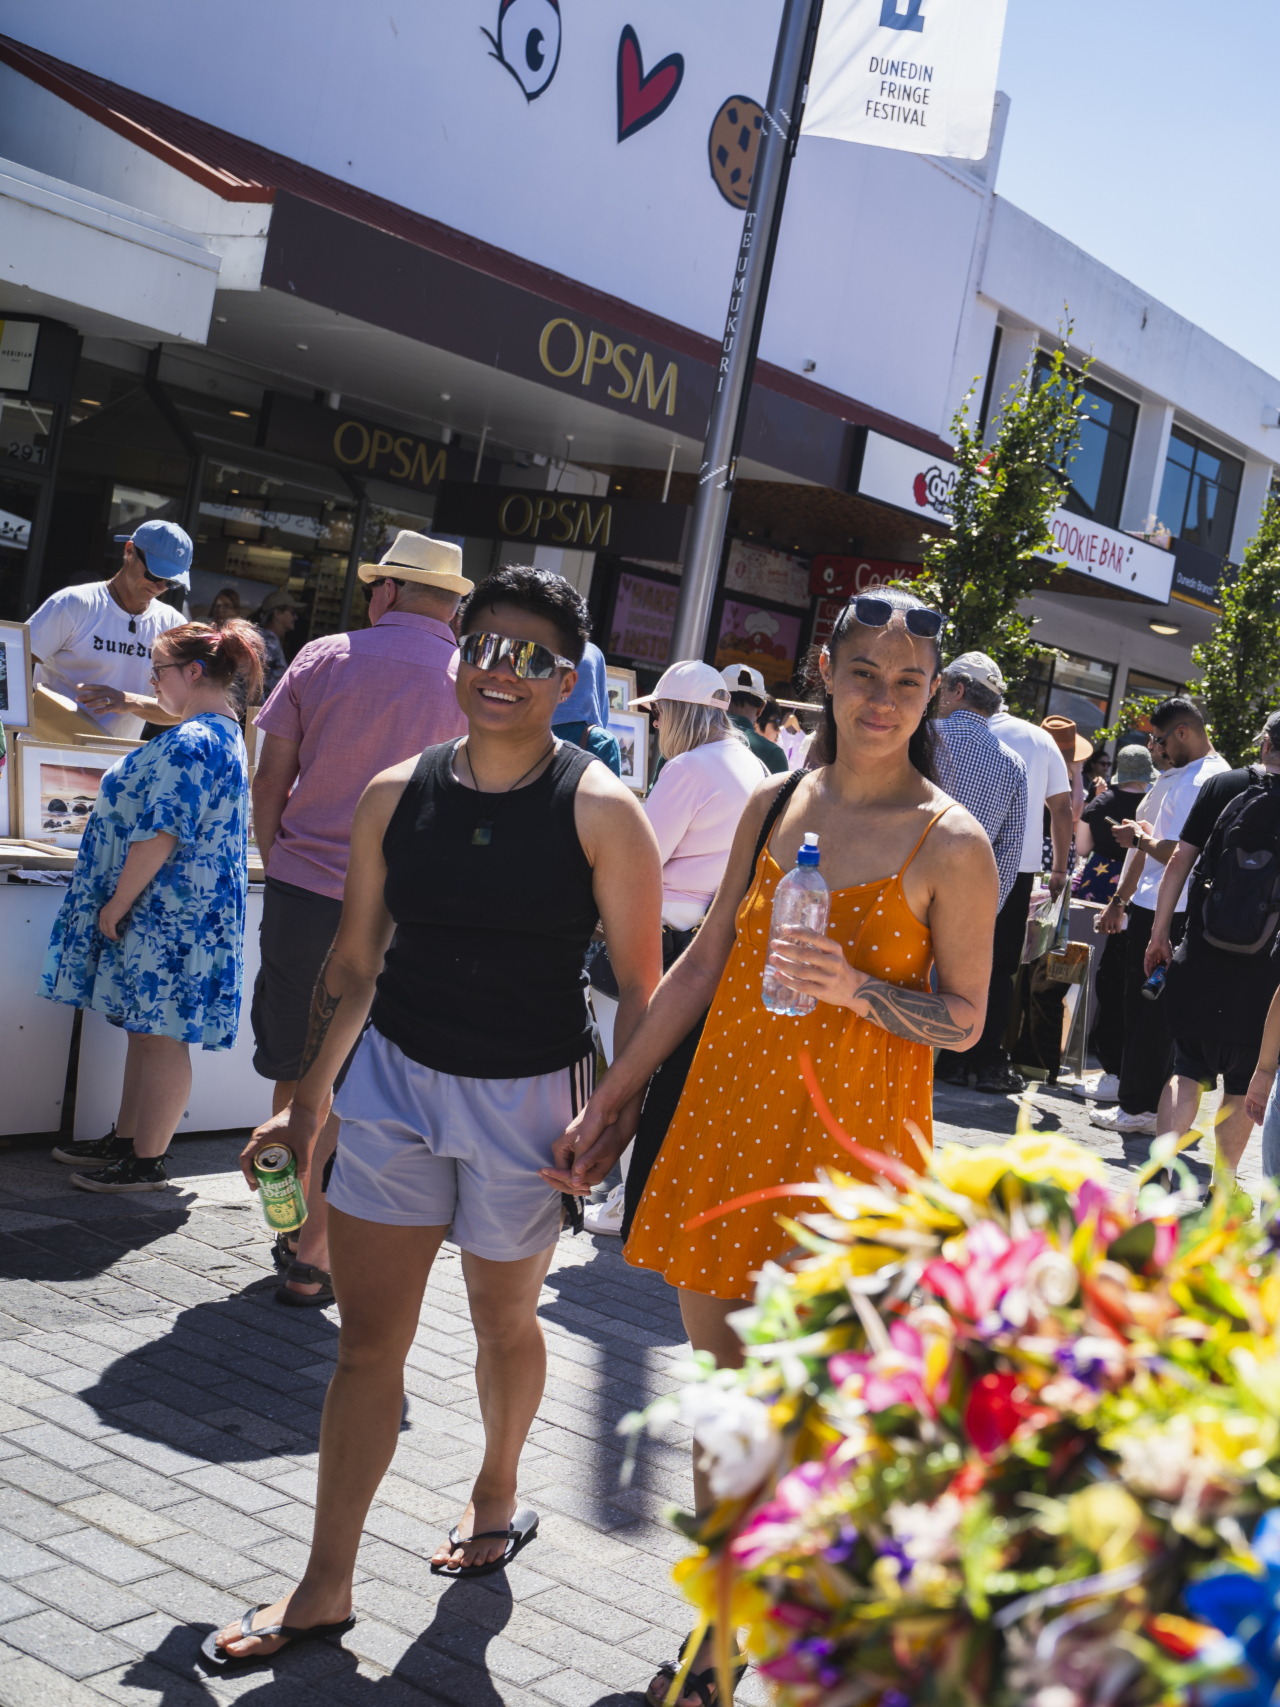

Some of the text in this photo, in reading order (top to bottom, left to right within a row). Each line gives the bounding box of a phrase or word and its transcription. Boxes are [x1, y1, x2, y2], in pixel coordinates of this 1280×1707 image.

[869, 56, 934, 83] DUNEDIN
[879, 80, 931, 105] FRINGE
[865, 99, 927, 127] FESTIVAL
[717, 212, 757, 392] TE UMUKURI
[1, 350, 33, 358] MERIDIAN
[539, 317, 678, 416] OPSM
[9, 441, 44, 463] 291
[333, 421, 447, 486] OPSM
[499, 494, 612, 546] OPSM
[1051, 519, 1125, 574] COOKIE BAR
[631, 582, 679, 616] BAKE
[622, 629, 669, 661] INSTO
[257, 1175, 295, 1191] Liquid
[262, 1184, 297, 1198] Death
